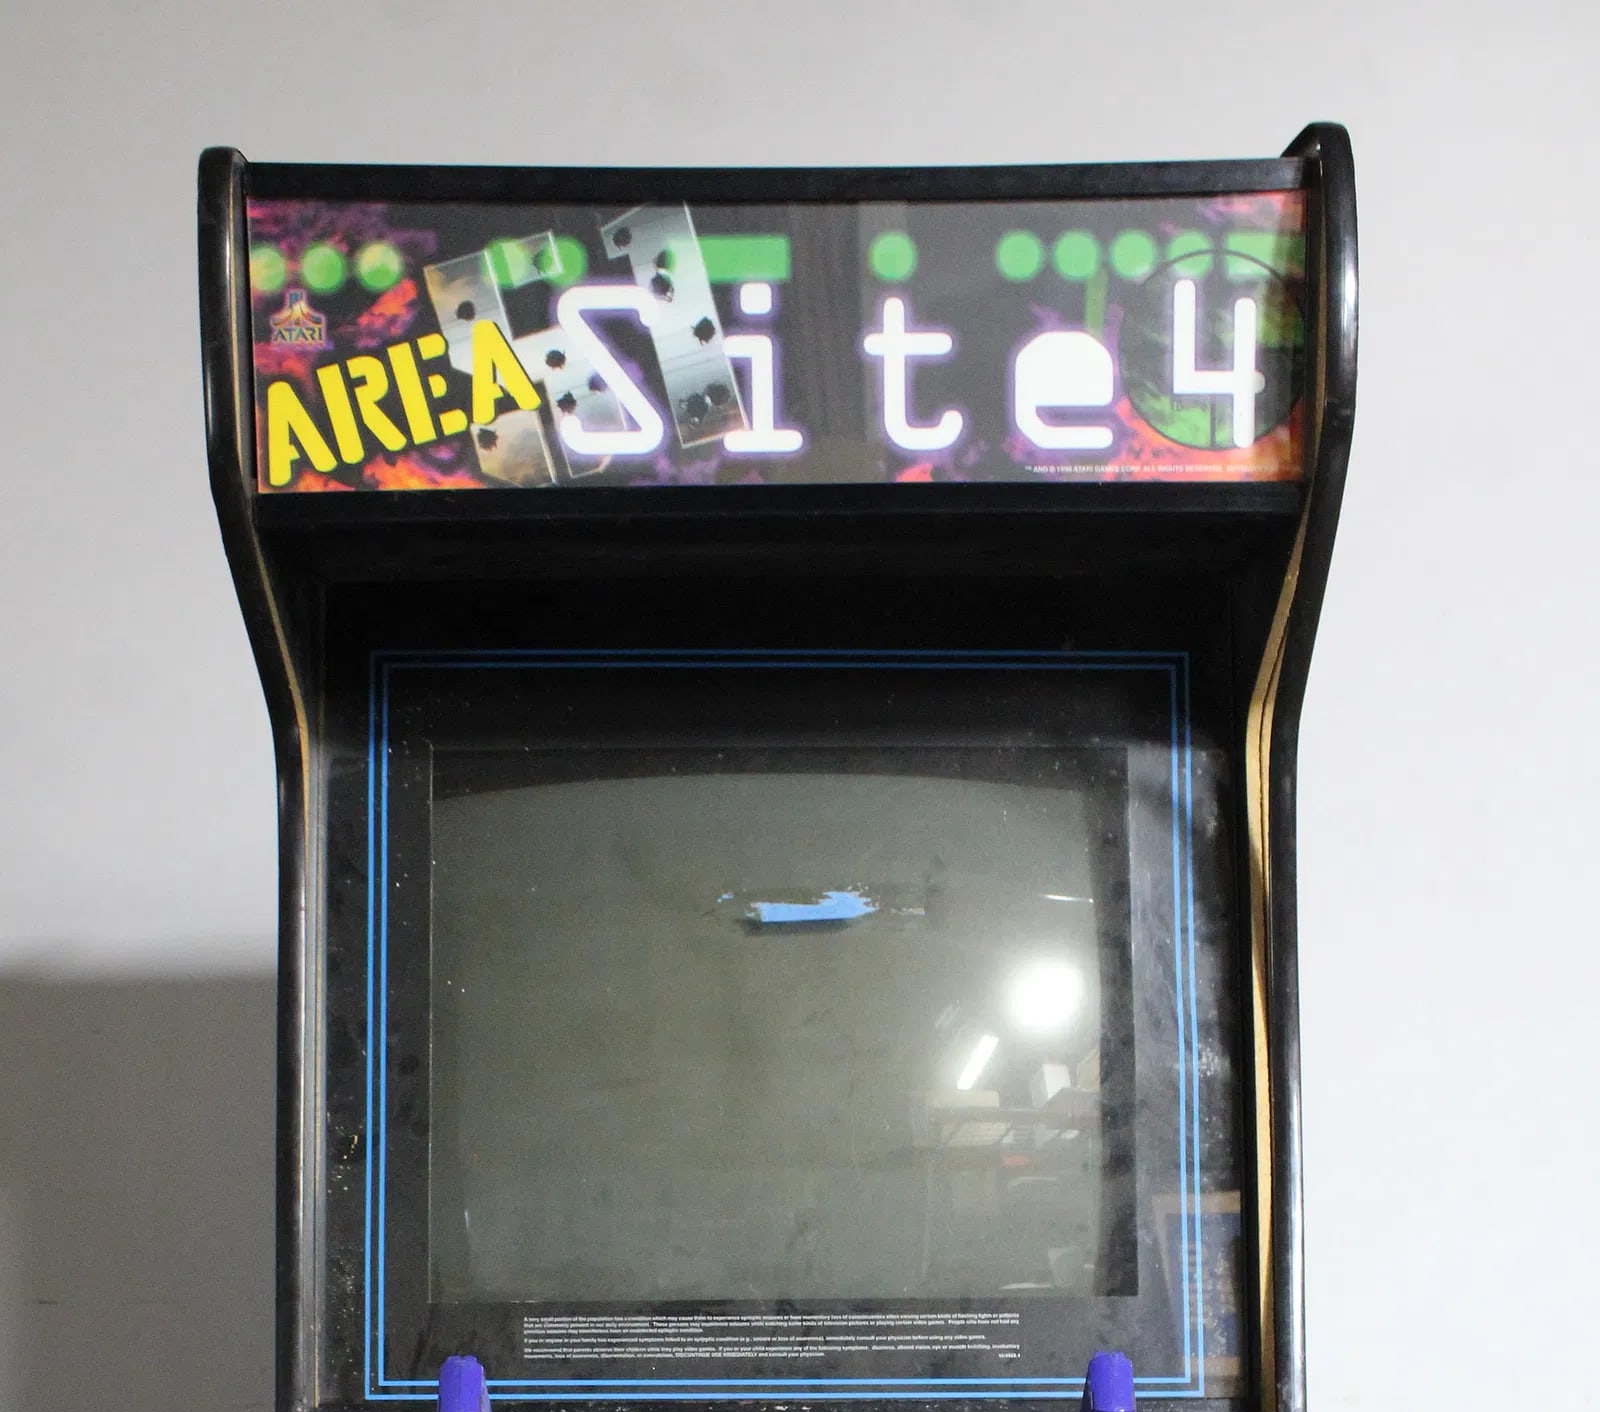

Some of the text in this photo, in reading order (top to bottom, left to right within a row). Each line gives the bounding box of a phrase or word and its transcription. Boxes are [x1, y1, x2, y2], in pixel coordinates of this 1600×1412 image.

[267, 319, 541, 488] AREA
[274, 327, 323, 342] ATARI
[556, 279, 1267, 454] Site 4
